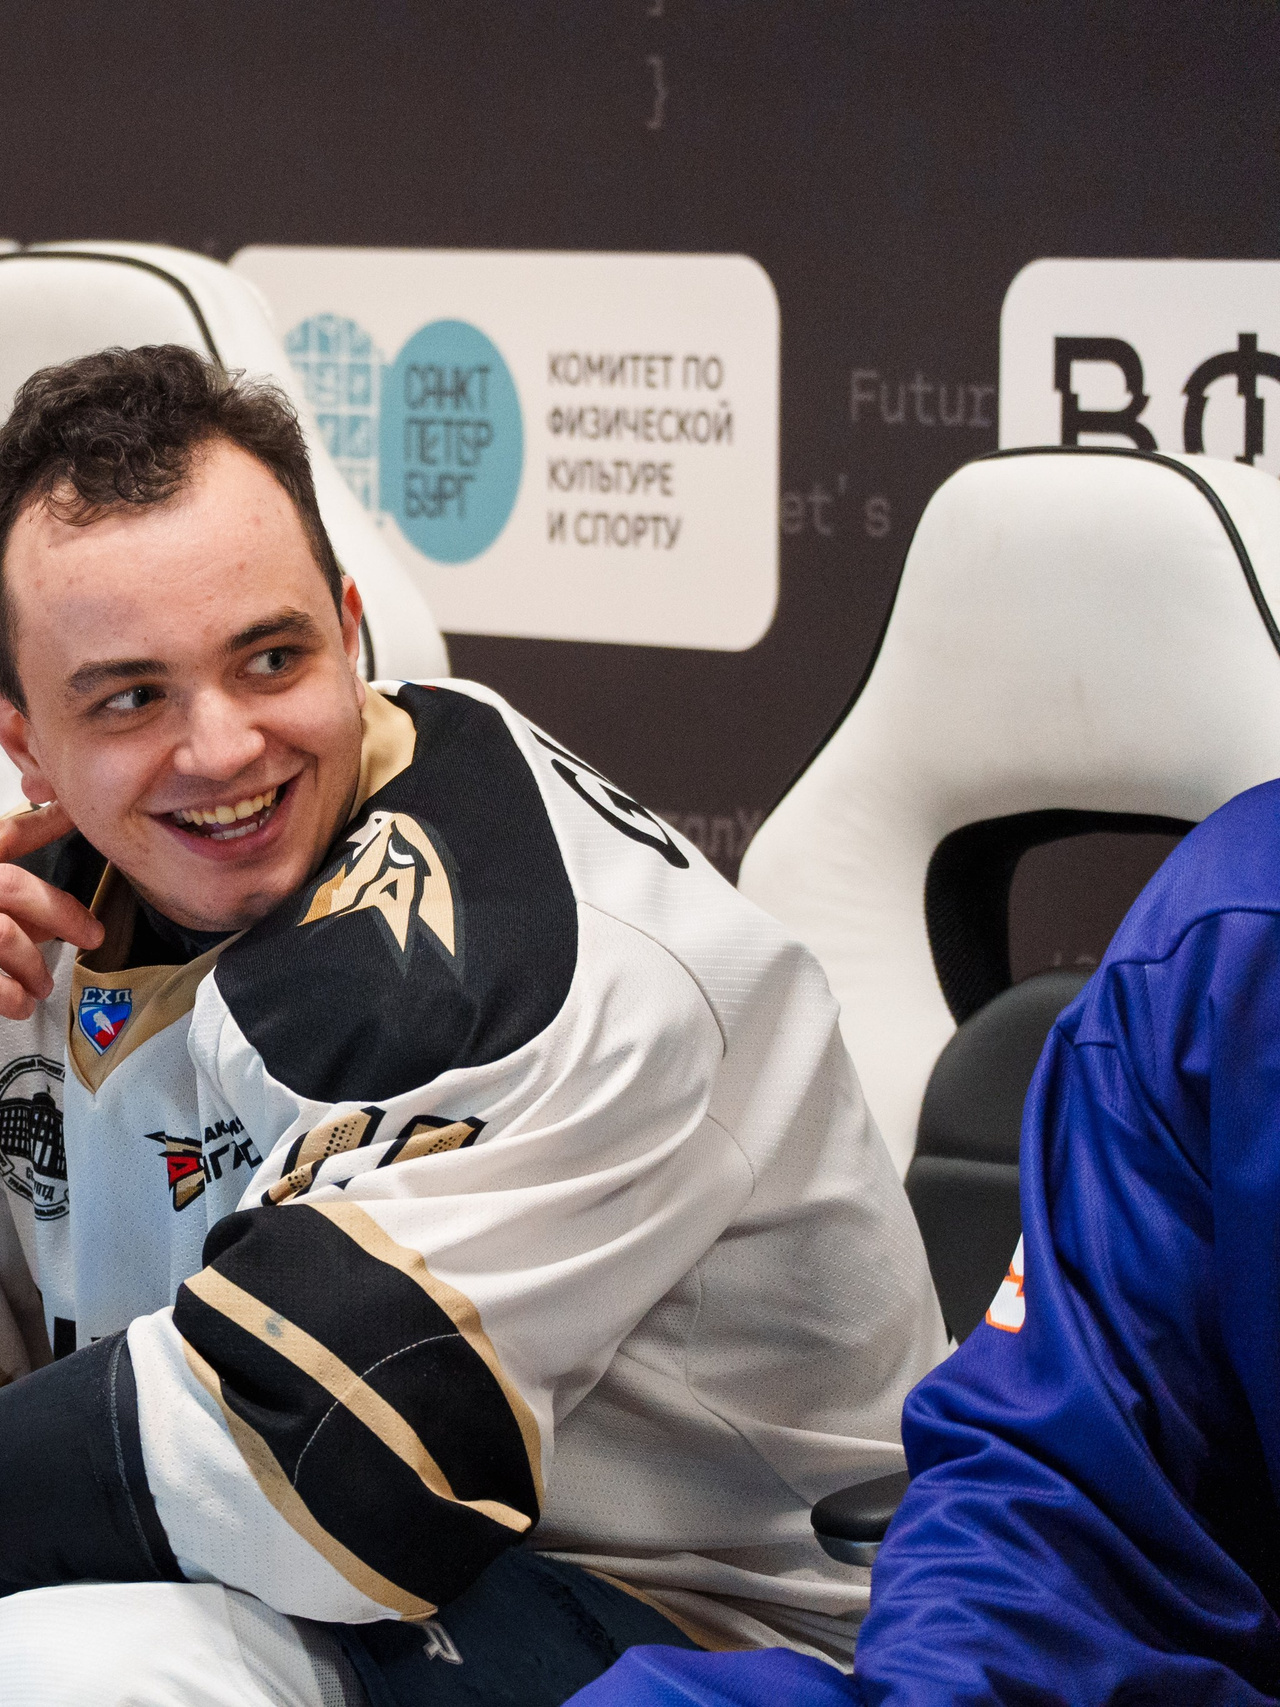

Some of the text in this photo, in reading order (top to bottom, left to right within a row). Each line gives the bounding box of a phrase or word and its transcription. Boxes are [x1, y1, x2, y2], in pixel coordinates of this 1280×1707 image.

[548, 351, 725, 391] КОМИТЕТ ПО
[404, 415, 495, 468] ПЕТЕР
[547, 399, 735, 446] ФИЗИЧЕСКОЙ
[404, 470, 477, 519] БУРГ
[547, 457, 675, 497] КУЛЬТУРЕ
[548, 509, 684, 550] И СПОРТУ
